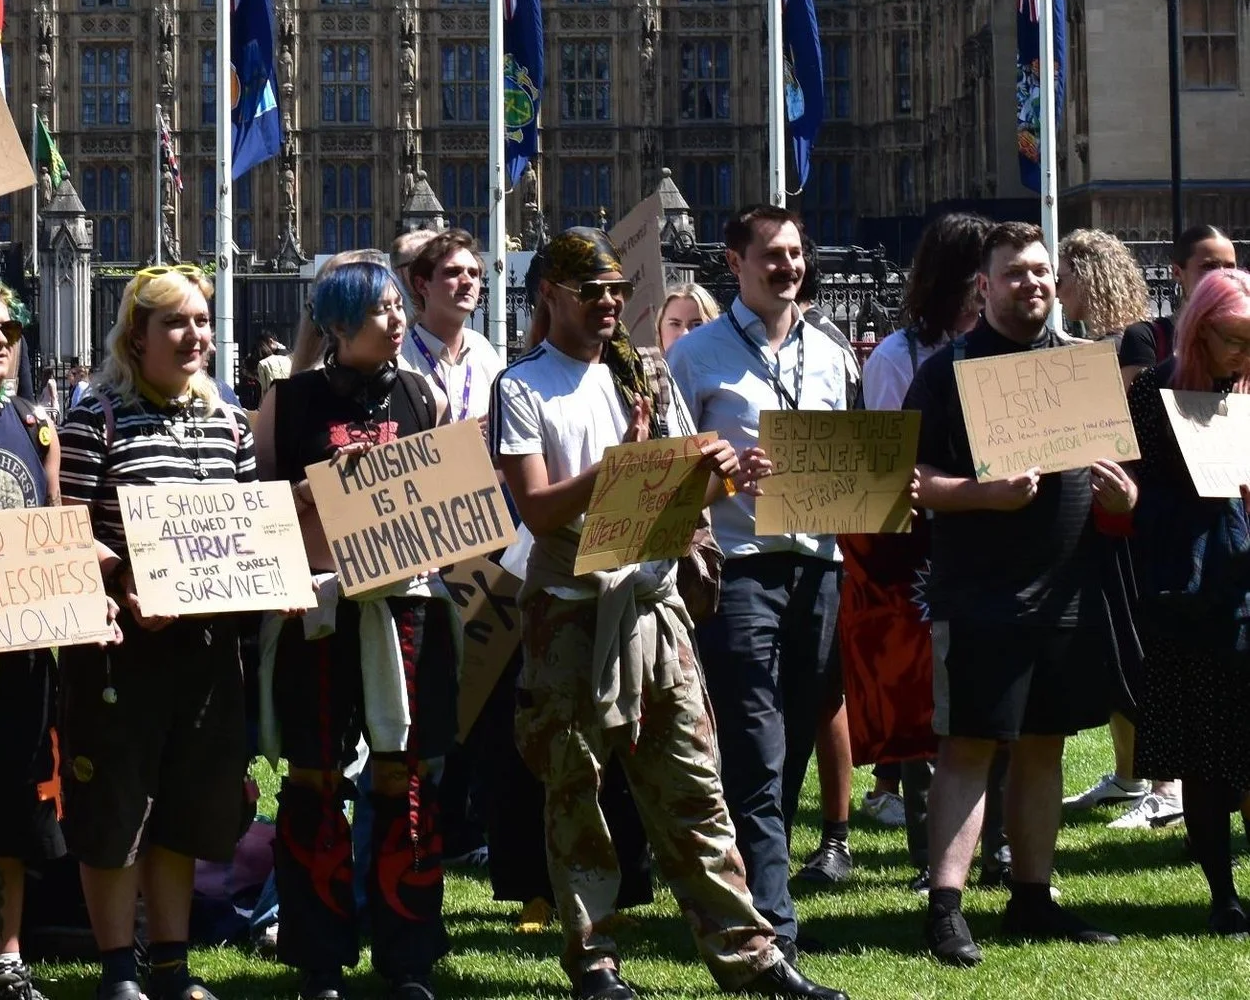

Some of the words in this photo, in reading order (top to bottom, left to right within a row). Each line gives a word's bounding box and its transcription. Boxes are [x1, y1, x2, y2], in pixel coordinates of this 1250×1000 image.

[975, 349, 1089, 397] PLEASE
[769, 413, 836, 441] END
[848, 413, 905, 440] THE
[336, 432, 441, 495] HOUSING
[770, 443, 901, 476] BENEFIT
[126, 495, 161, 522] WE
[166, 492, 235, 518] SHOULD
[243, 490, 269, 511] BE
[371, 488, 396, 517] IS
[404, 479, 422, 505] A
[794, 475, 857, 512] TRAP
[17, 509, 94, 549] YOUTH
[161, 517, 226, 537] ALLOWED
[230, 516, 252, 530] TO
[332, 511, 431, 587] HUMAN
[421, 486, 504, 557] RIGHT
[170, 533, 255, 564] THRIVE
[149, 569, 169, 580] NOT
[190, 565, 220, 577] JUST
[237, 556, 280, 573] BARELY
